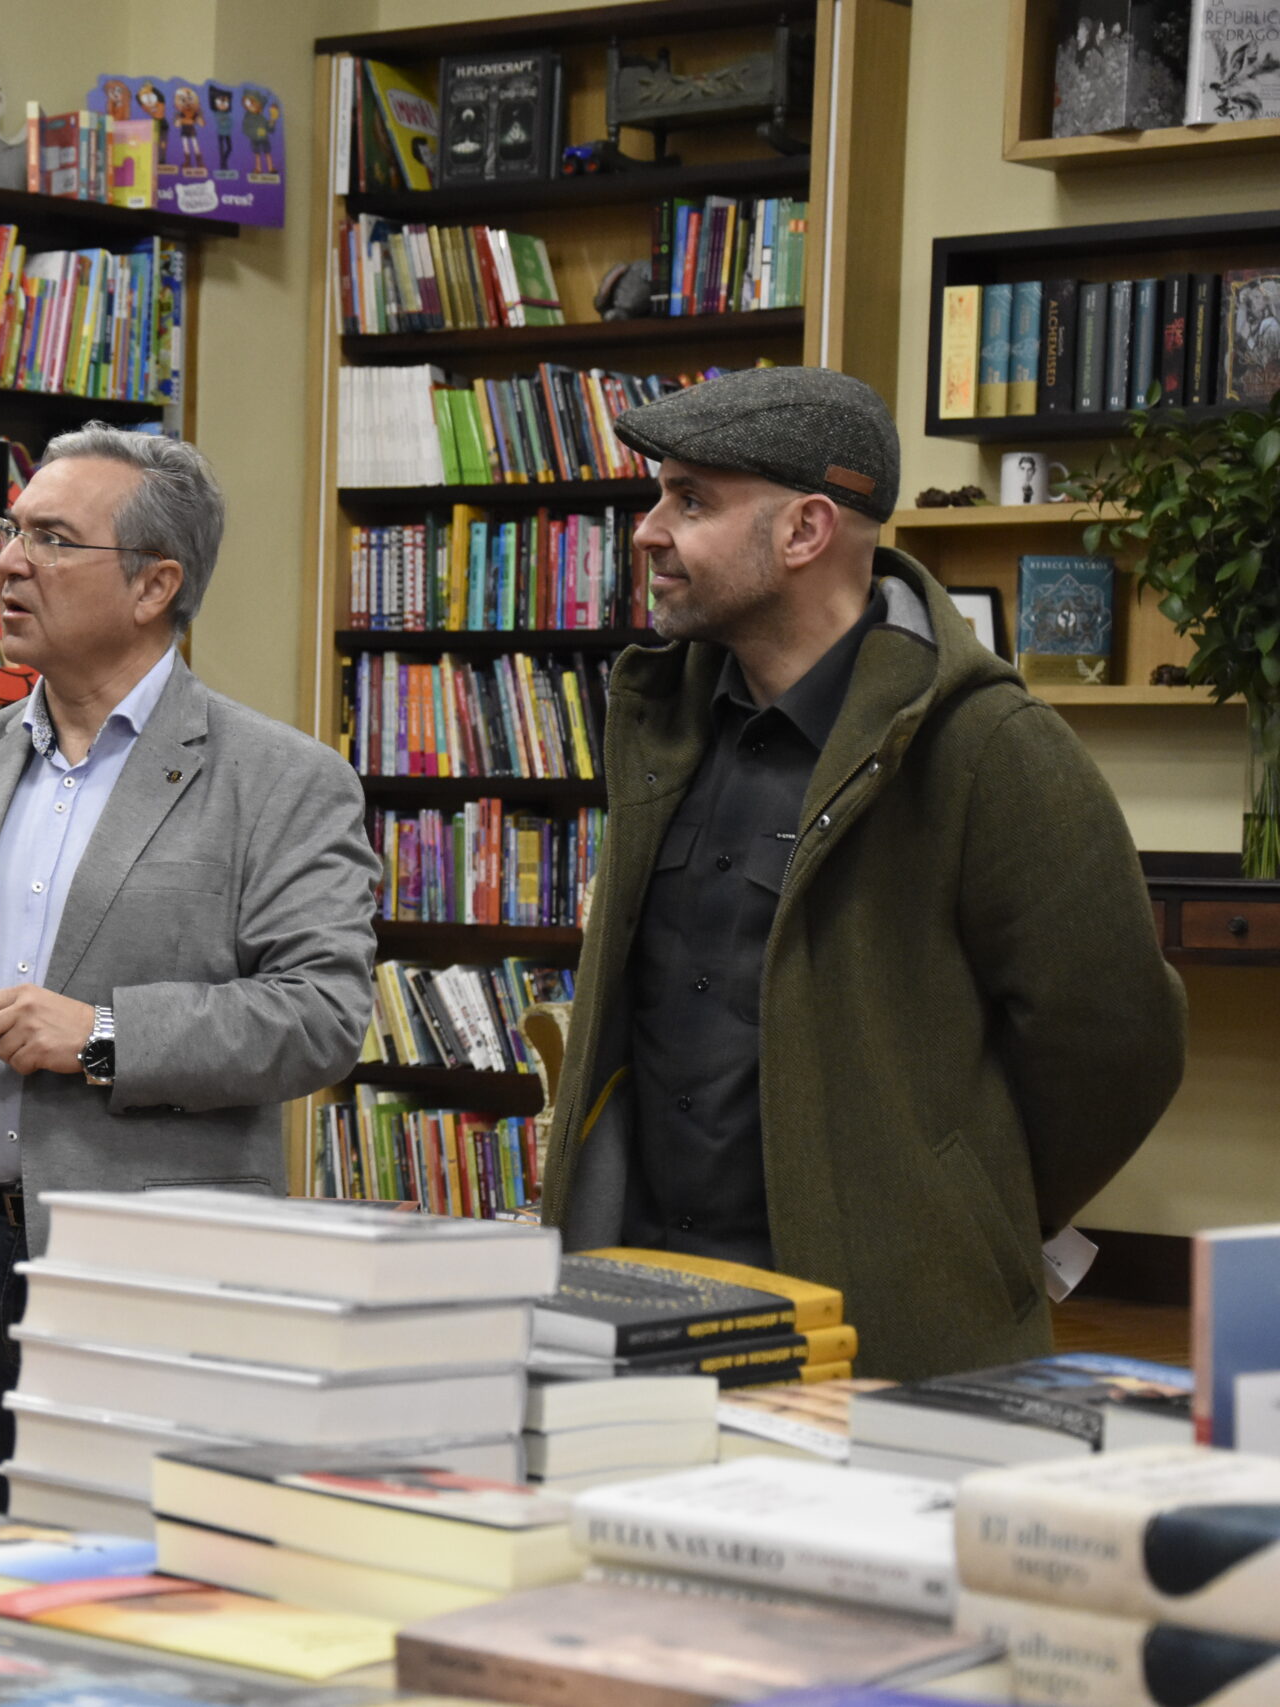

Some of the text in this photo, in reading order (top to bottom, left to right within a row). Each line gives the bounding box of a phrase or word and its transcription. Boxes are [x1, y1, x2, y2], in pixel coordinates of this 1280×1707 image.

[1205, 8, 1280, 25] REPUBLIC
[1226, 28, 1280, 41] DRAGO
[1046, 299, 1059, 387] ALCHEMISED
[1029, 561, 1071, 570] REBECCA
[588, 1519, 787, 1571] JULIA NAVARRO
[980, 1516, 1118, 1559] El albatros
[1015, 1555, 1091, 1585] negro
